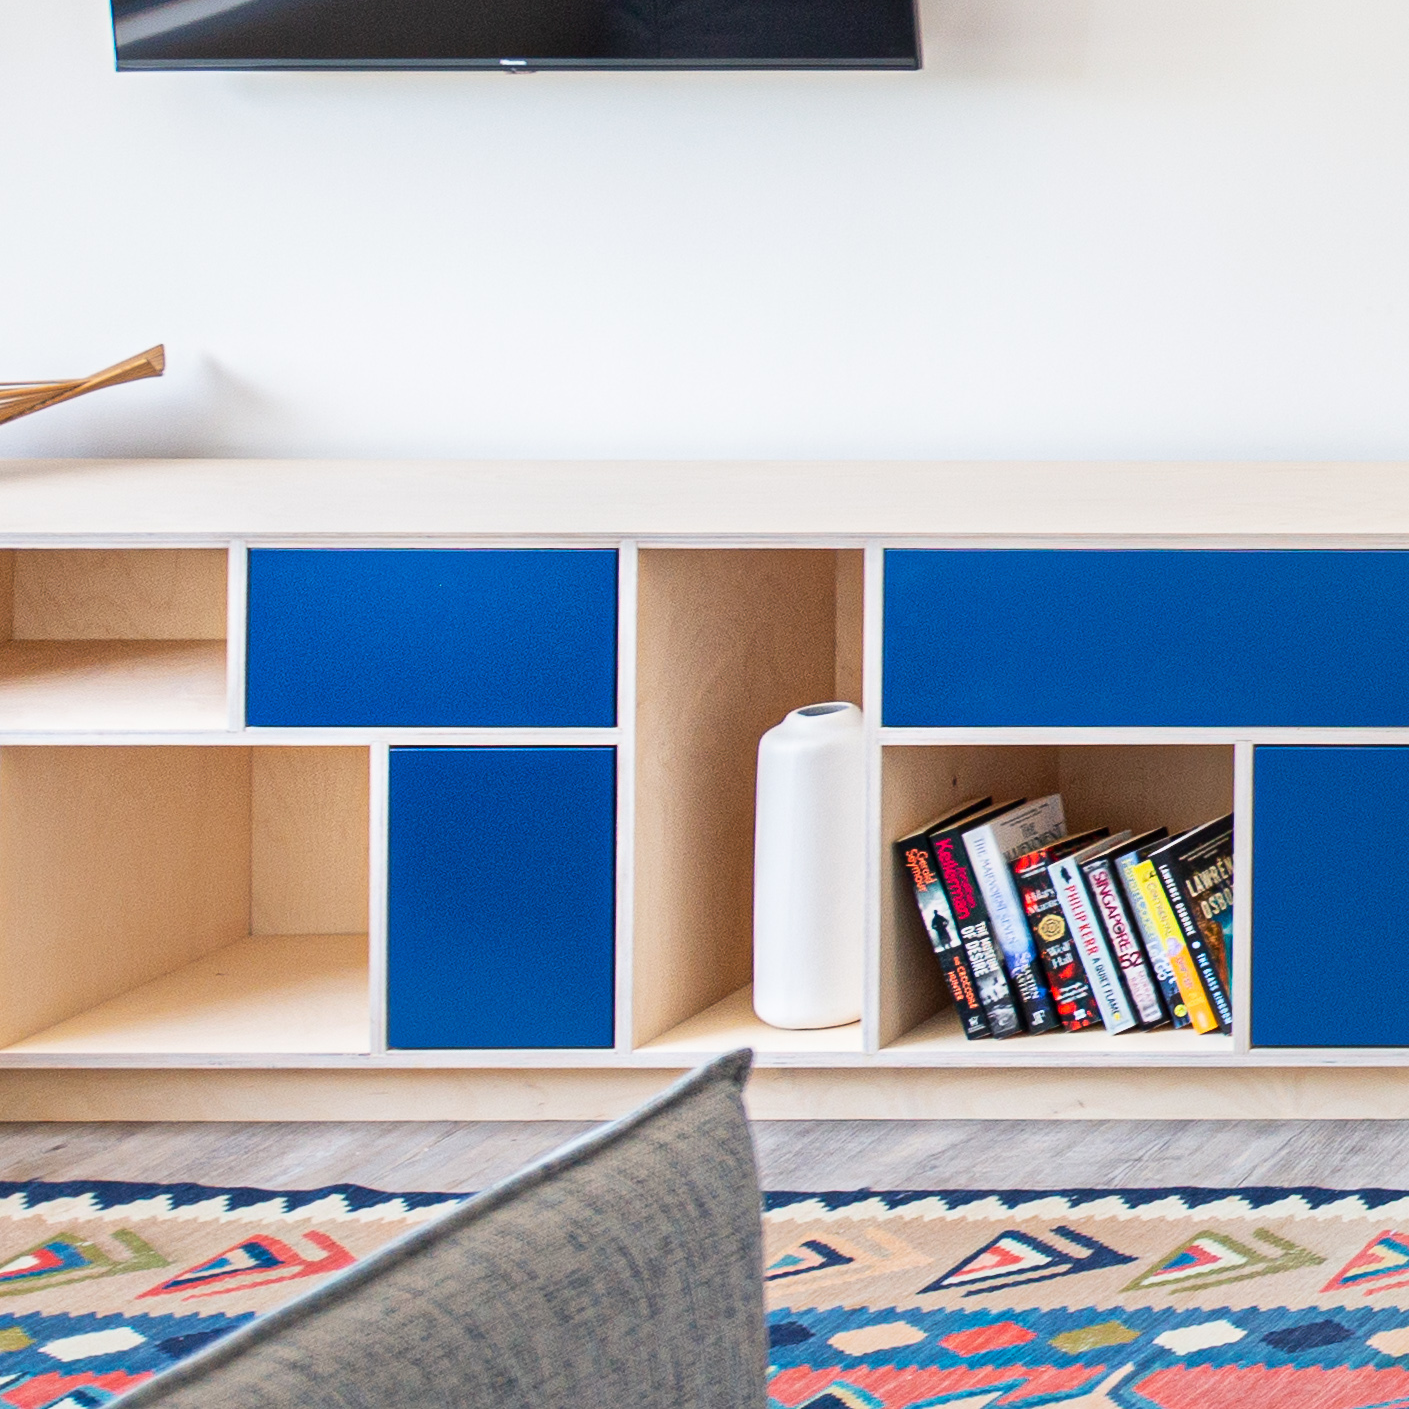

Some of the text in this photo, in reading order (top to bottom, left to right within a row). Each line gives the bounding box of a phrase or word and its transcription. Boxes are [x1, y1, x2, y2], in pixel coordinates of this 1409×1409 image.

[905, 847, 928, 893] Seymour
[917, 850, 938, 885] Gerald
[935, 838, 971, 920] Kellerman
[1063, 884, 1100, 955] PHILIP KERR
[1092, 870, 1132, 952] SINGAPORE
[959, 924, 989, 978] OF DESIRE
[1091, 956, 1101, 964] A
[1158, 864, 1232, 1025] LAWRENCE OSBORNE THE GLASS KINGDOM
[947, 970, 964, 1001] HUNTER
[956, 965, 978, 1009] CROCODILE
[1093, 963, 1110, 988] QUIET
